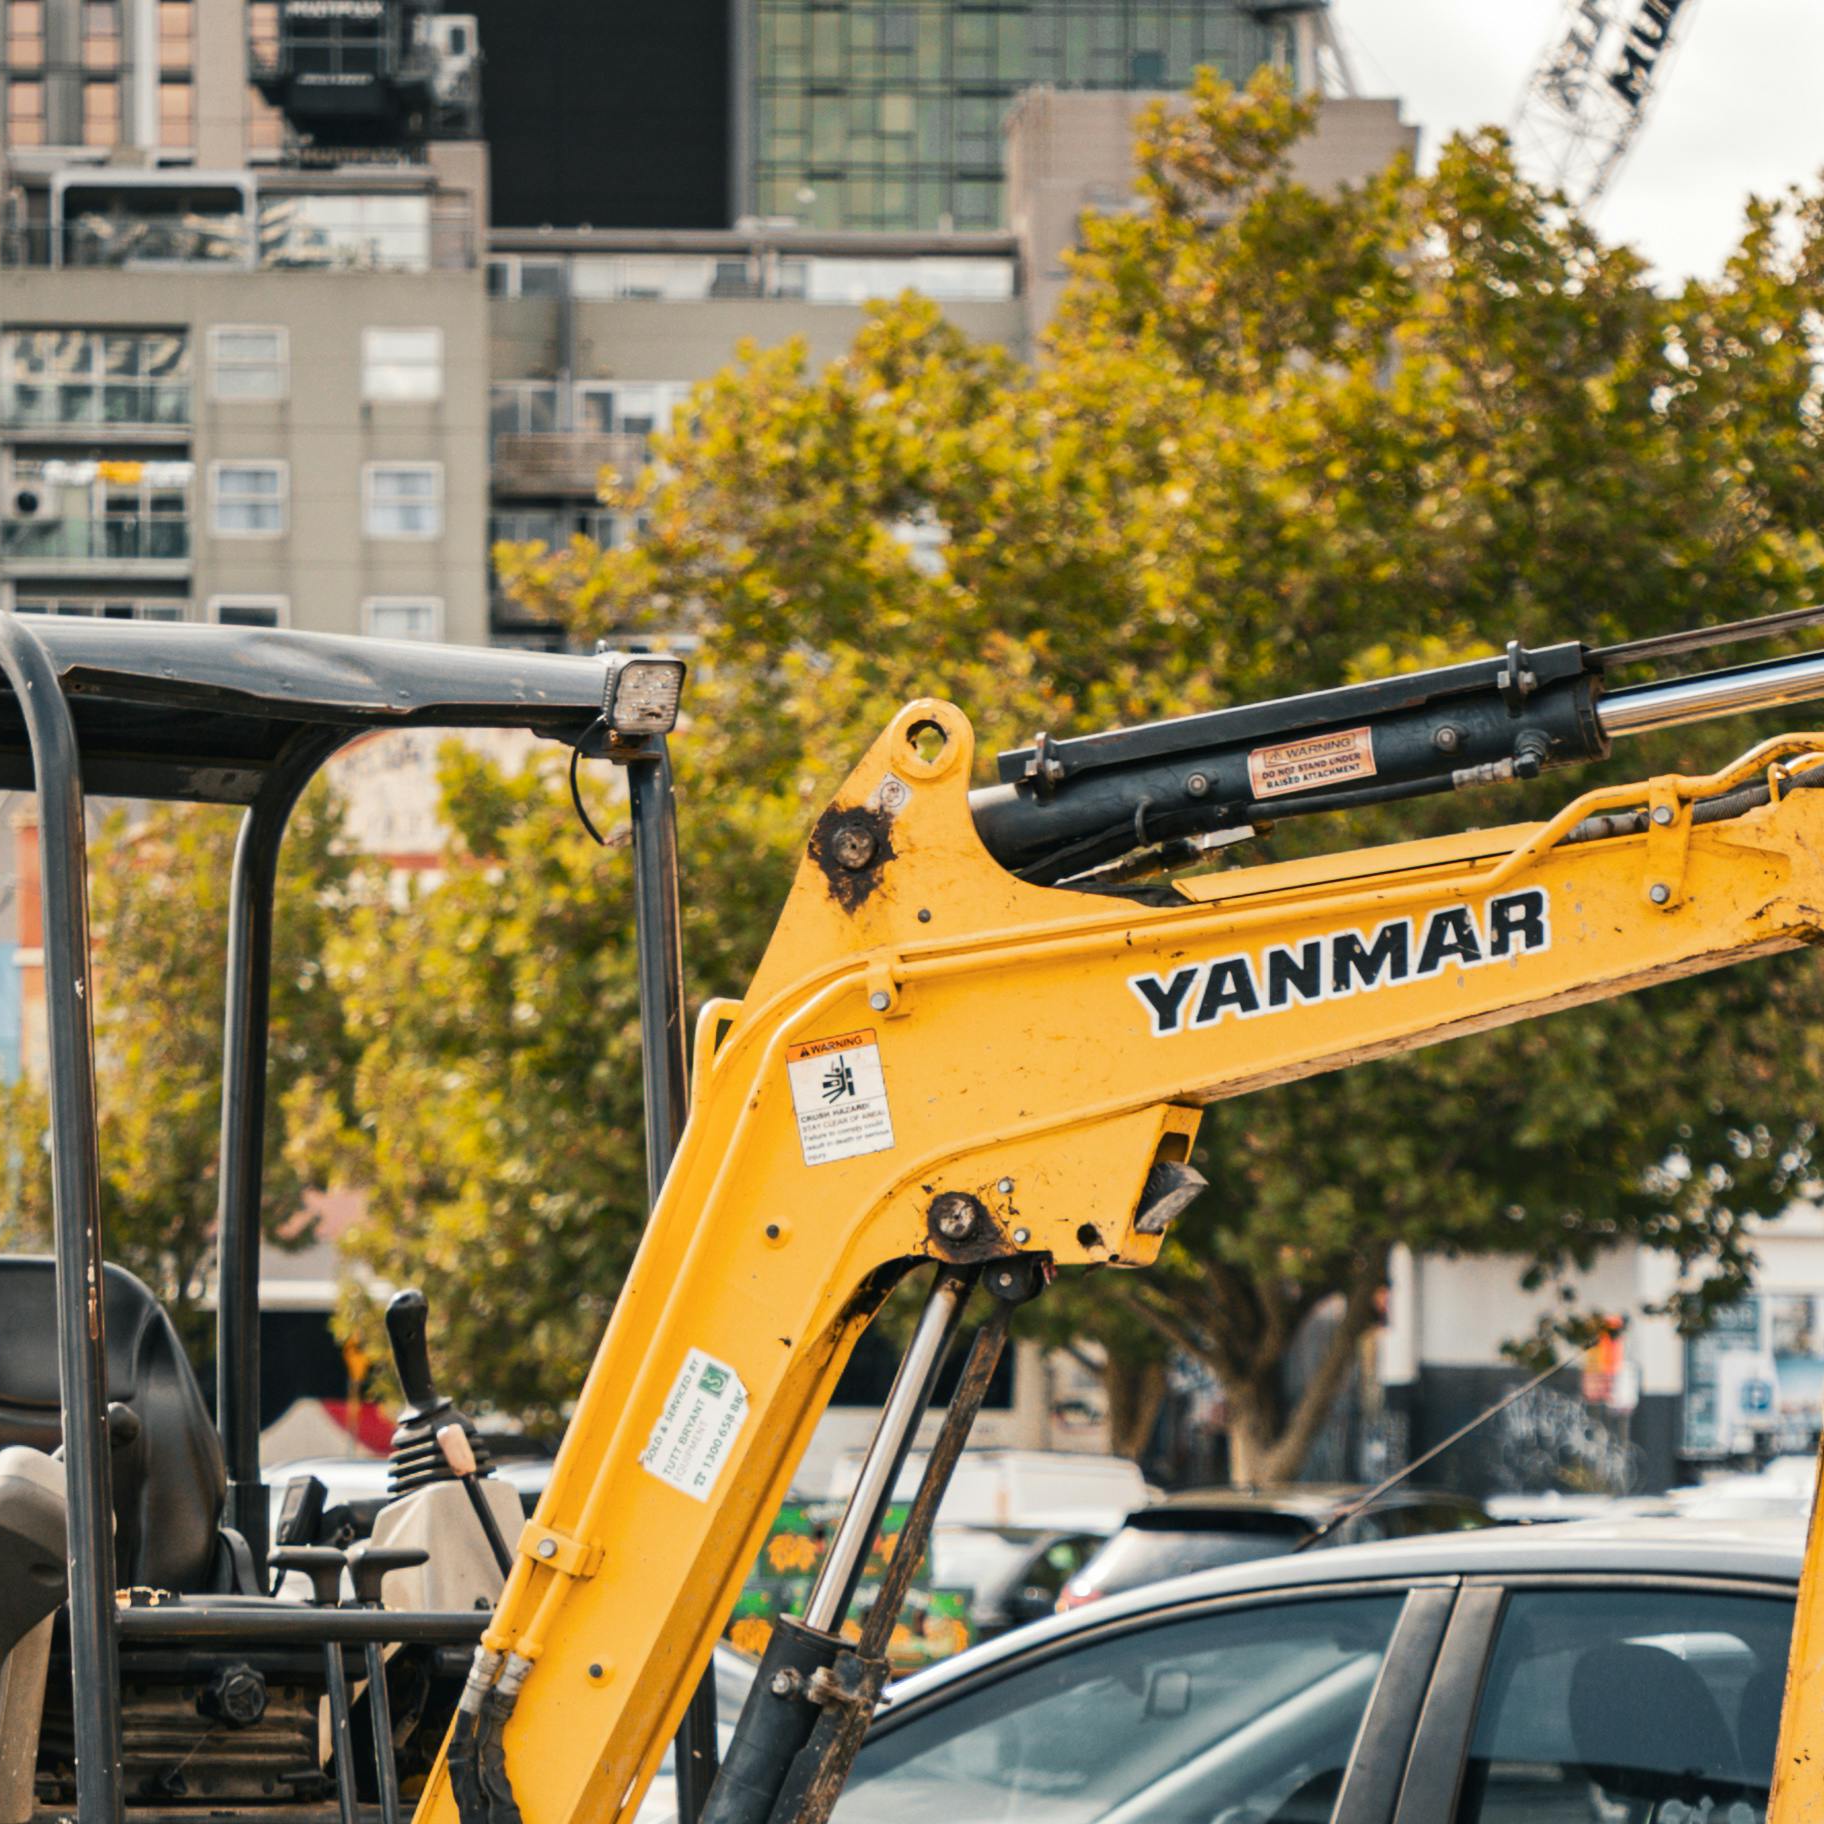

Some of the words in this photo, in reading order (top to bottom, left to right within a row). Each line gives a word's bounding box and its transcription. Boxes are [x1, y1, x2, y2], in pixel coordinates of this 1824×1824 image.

[1286, 738, 1352, 758] WARNING
[1262, 770, 1276, 780] DO
[1277, 766, 1296, 776] NOT
[1297, 759, 1328, 772] STAND
[1329, 752, 1361, 766] UNDER
[1266, 775, 1300, 789] RAISED
[1303, 763, 1360, 781] ATTACHMENT
[1134, 889, 1546, 1032] YANMAR
[811, 1035, 863, 1054] WARNING
[800, 1111, 831, 1123] CRUSH
[823, 1117, 849, 1129] CLEAR
[646, 1436, 663, 1464] SOLD
[665, 1374, 692, 1424] SERVICED
[662, 1448, 682, 1475] TUTT
[678, 1398, 705, 1446] BRYANT
[703, 1438, 724, 1469] 1300
[718, 1413, 736, 1438] 658
[674, 1420, 709, 1482] EQUIPMENT
